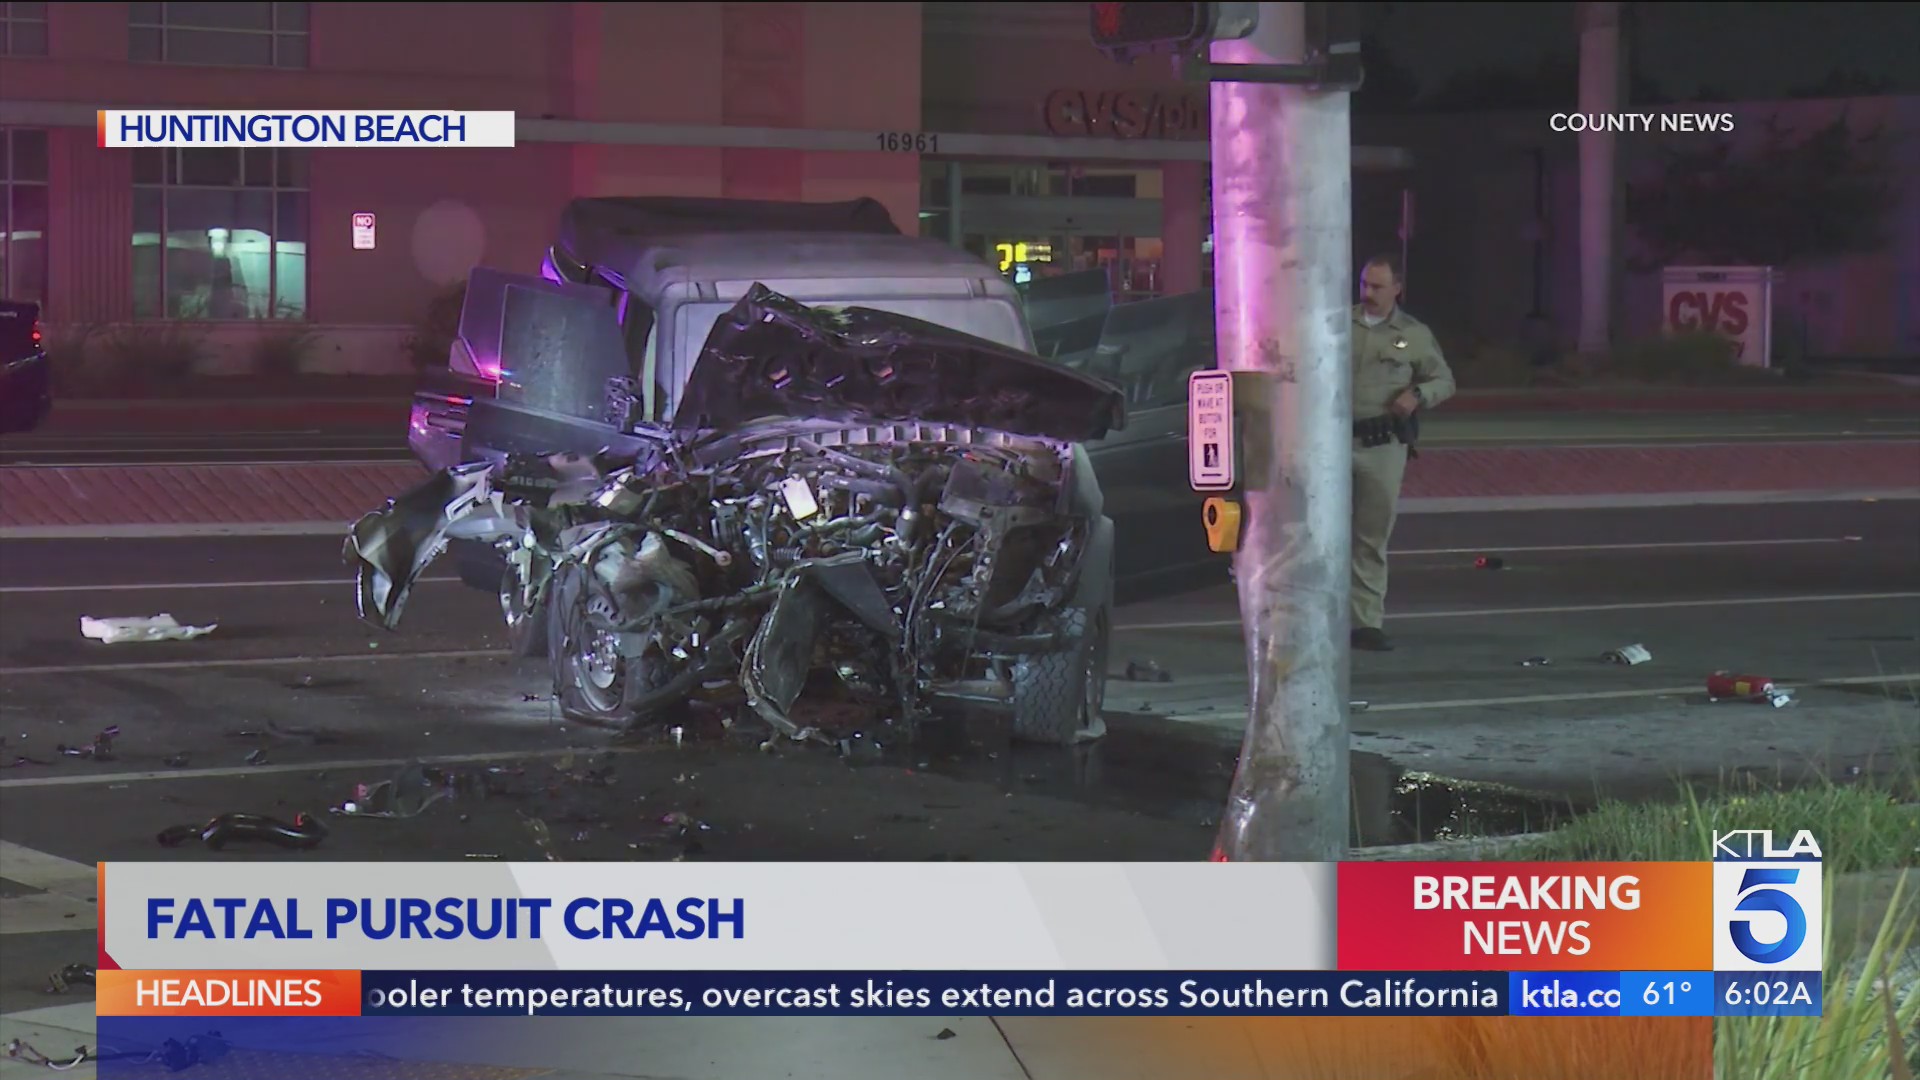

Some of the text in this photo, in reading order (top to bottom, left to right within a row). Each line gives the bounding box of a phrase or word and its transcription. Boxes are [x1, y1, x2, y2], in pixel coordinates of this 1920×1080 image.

[877, 132, 938, 153] 16961
[356, 216, 372, 226] NO
[1670, 291, 1748, 335] CVS
[1197, 382, 1224, 394] PUSH OR
[1198, 397, 1224, 409] WAVE AT
[1199, 413, 1222, 424] BUTTON
[1204, 427, 1217, 438] FOR
